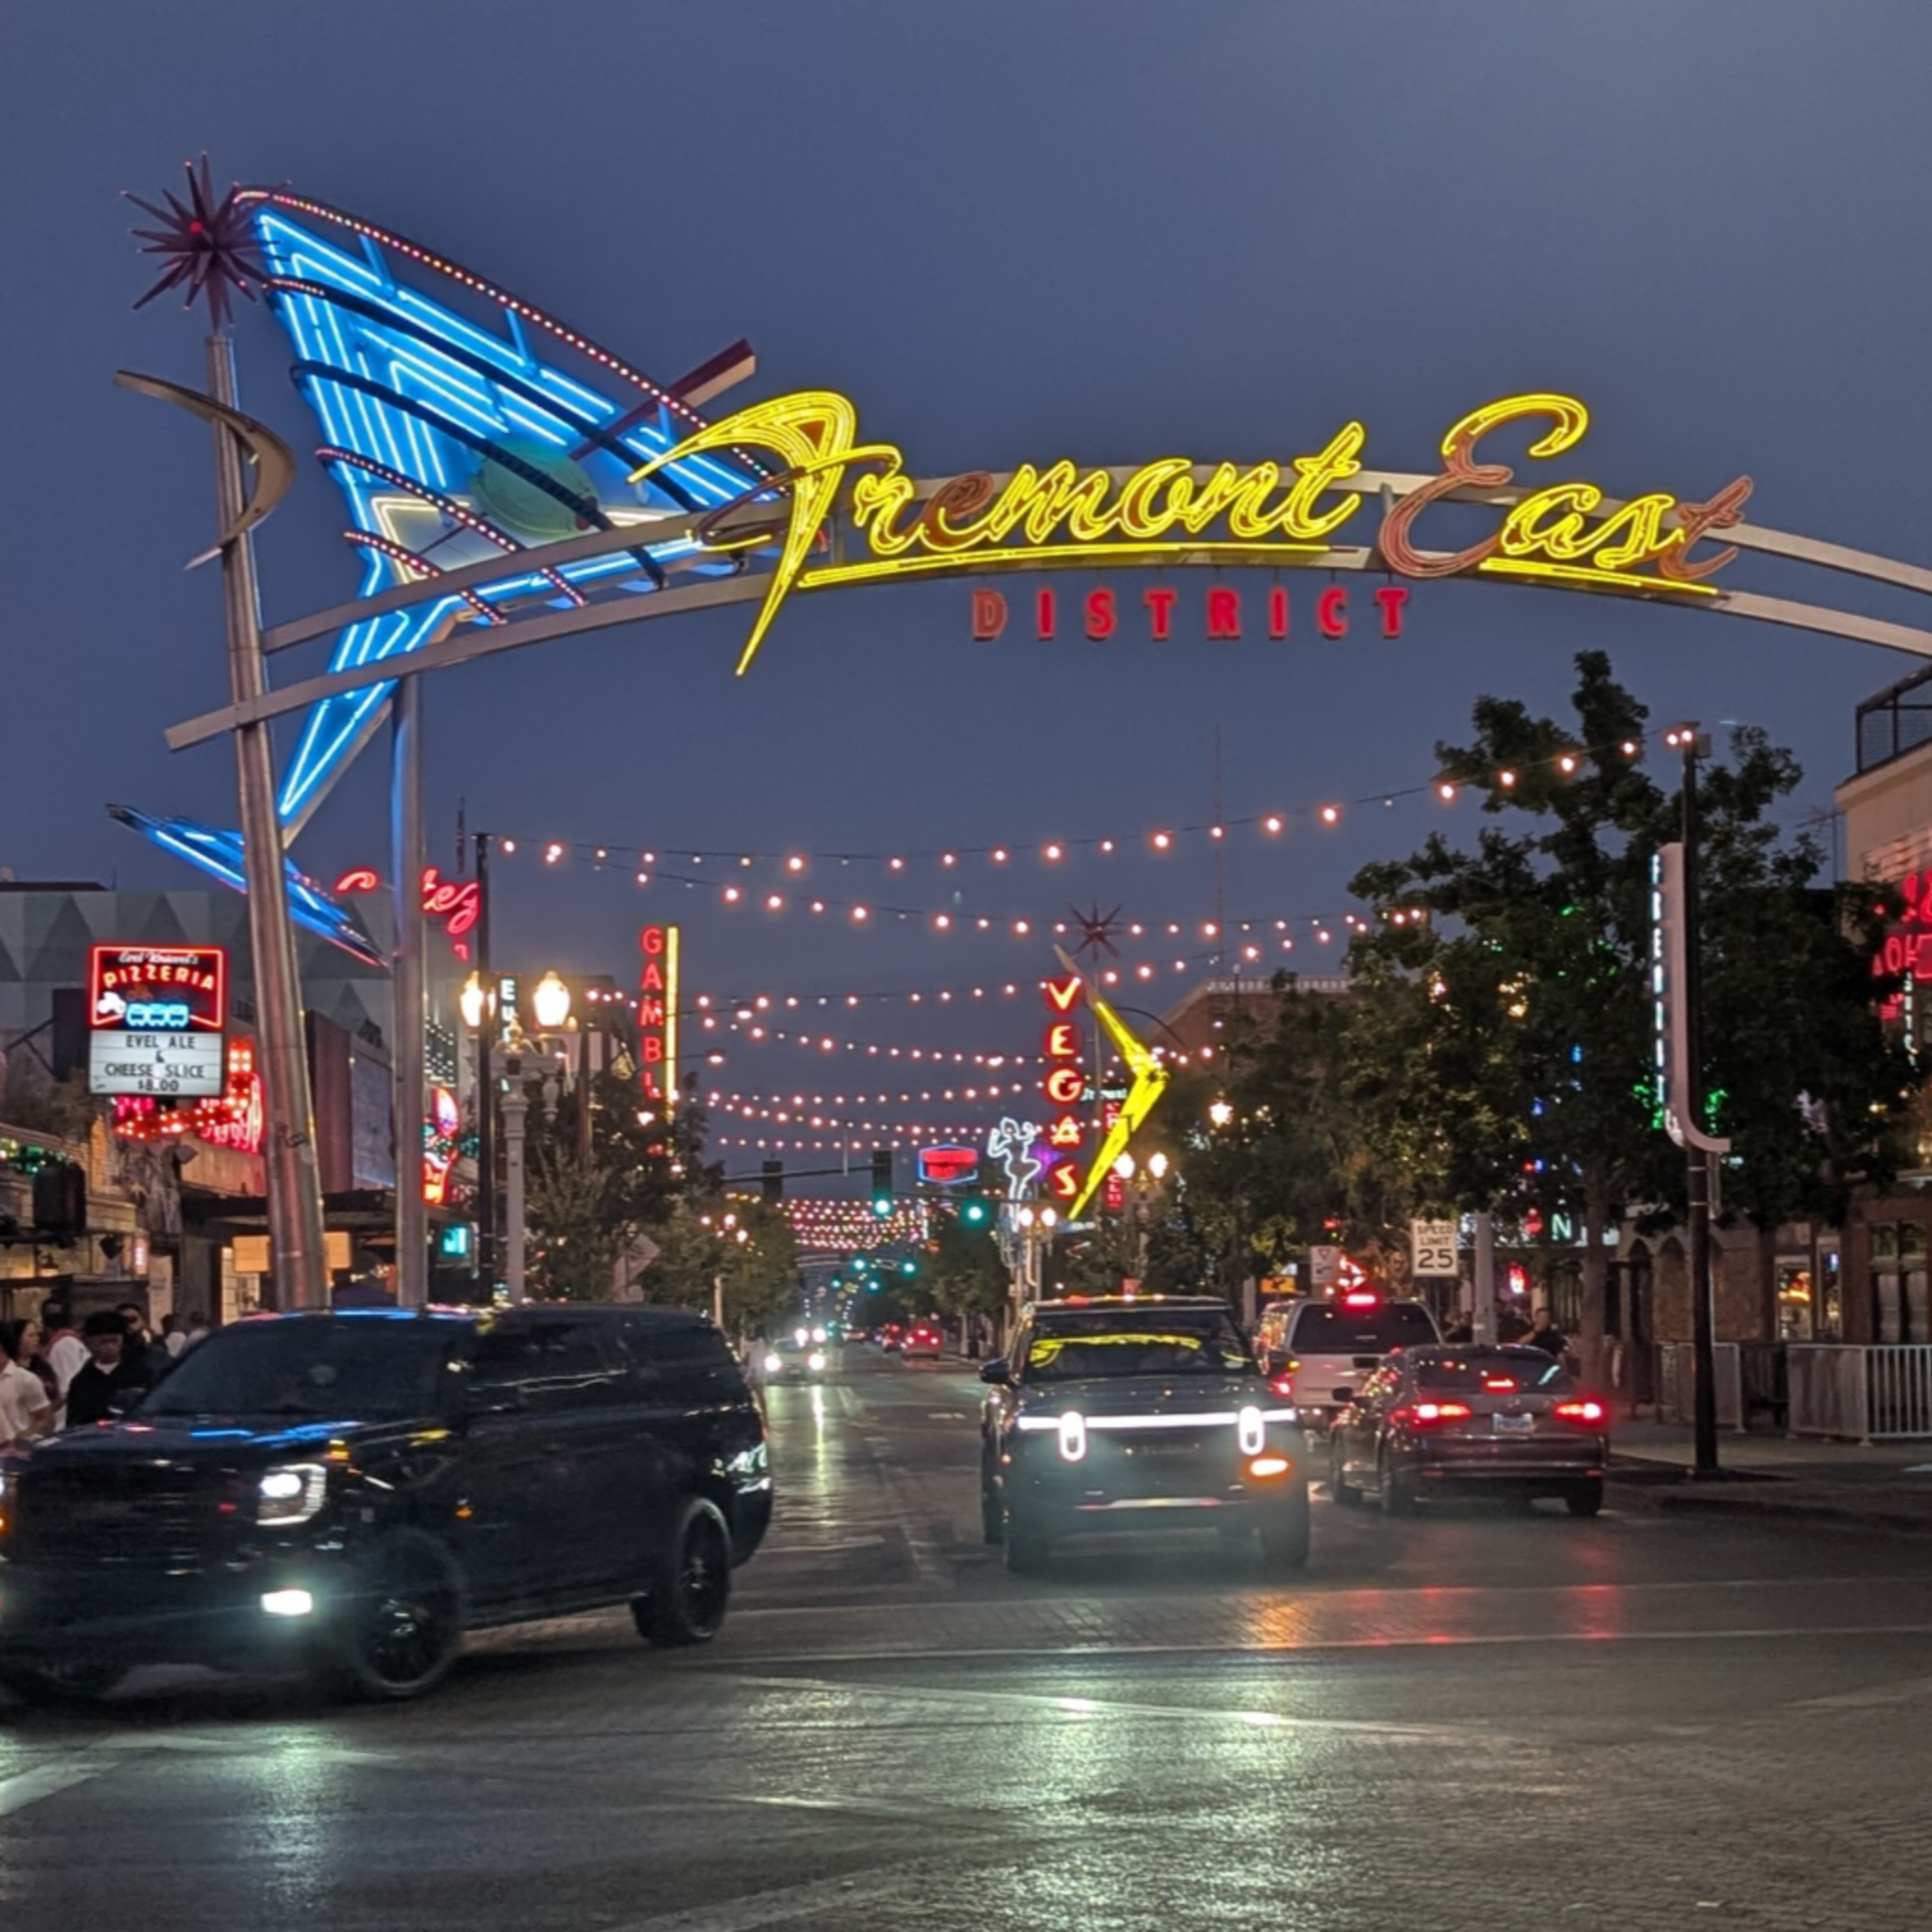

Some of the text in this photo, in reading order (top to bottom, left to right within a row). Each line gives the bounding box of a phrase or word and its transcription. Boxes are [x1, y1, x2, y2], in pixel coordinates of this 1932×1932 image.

[627, 391, 1754, 676] Fremont East
[972, 587, 1411, 640] DISTRICT
[104, 963, 214, 990] PIZZERIA
[640, 926, 663, 1099] GAMBL
[126, 1035, 196, 1049] EVEL ALE
[104, 1063, 205, 1078] CHEESE SLICE
[137, 1079, 180, 1092] $8.00
[1048, 980, 1083, 1196] VEGAS
[1417, 1225, 1454, 1235] SPEED
[1420, 1236, 1450, 1246] LIMIT
[1418, 1248, 1454, 1269] 25
